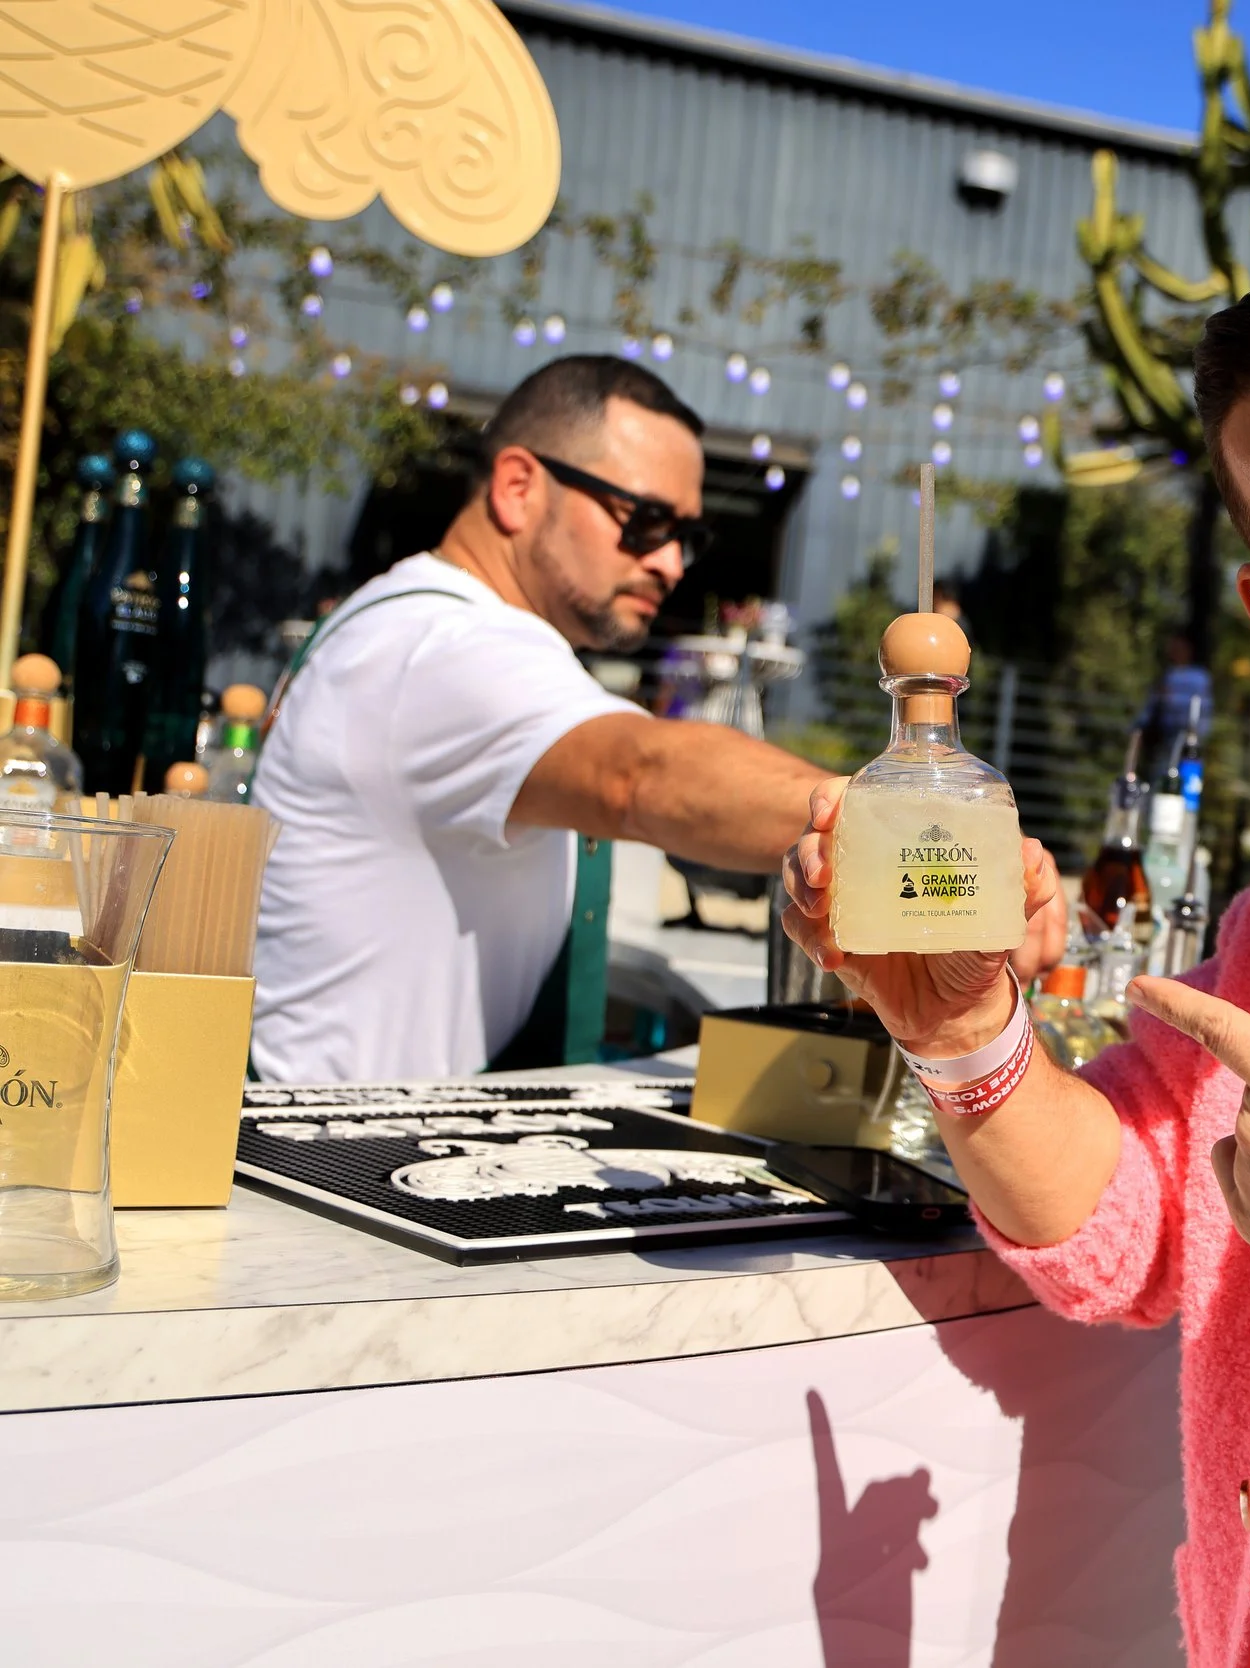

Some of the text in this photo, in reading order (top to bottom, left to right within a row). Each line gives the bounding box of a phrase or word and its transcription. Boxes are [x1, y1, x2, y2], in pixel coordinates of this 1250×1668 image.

[900, 843, 974, 862] PATRÓN
[921, 874, 977, 885] GRAMMY
[922, 886, 976, 897] AWARDS
[951, 909, 978, 917] PARTNER
